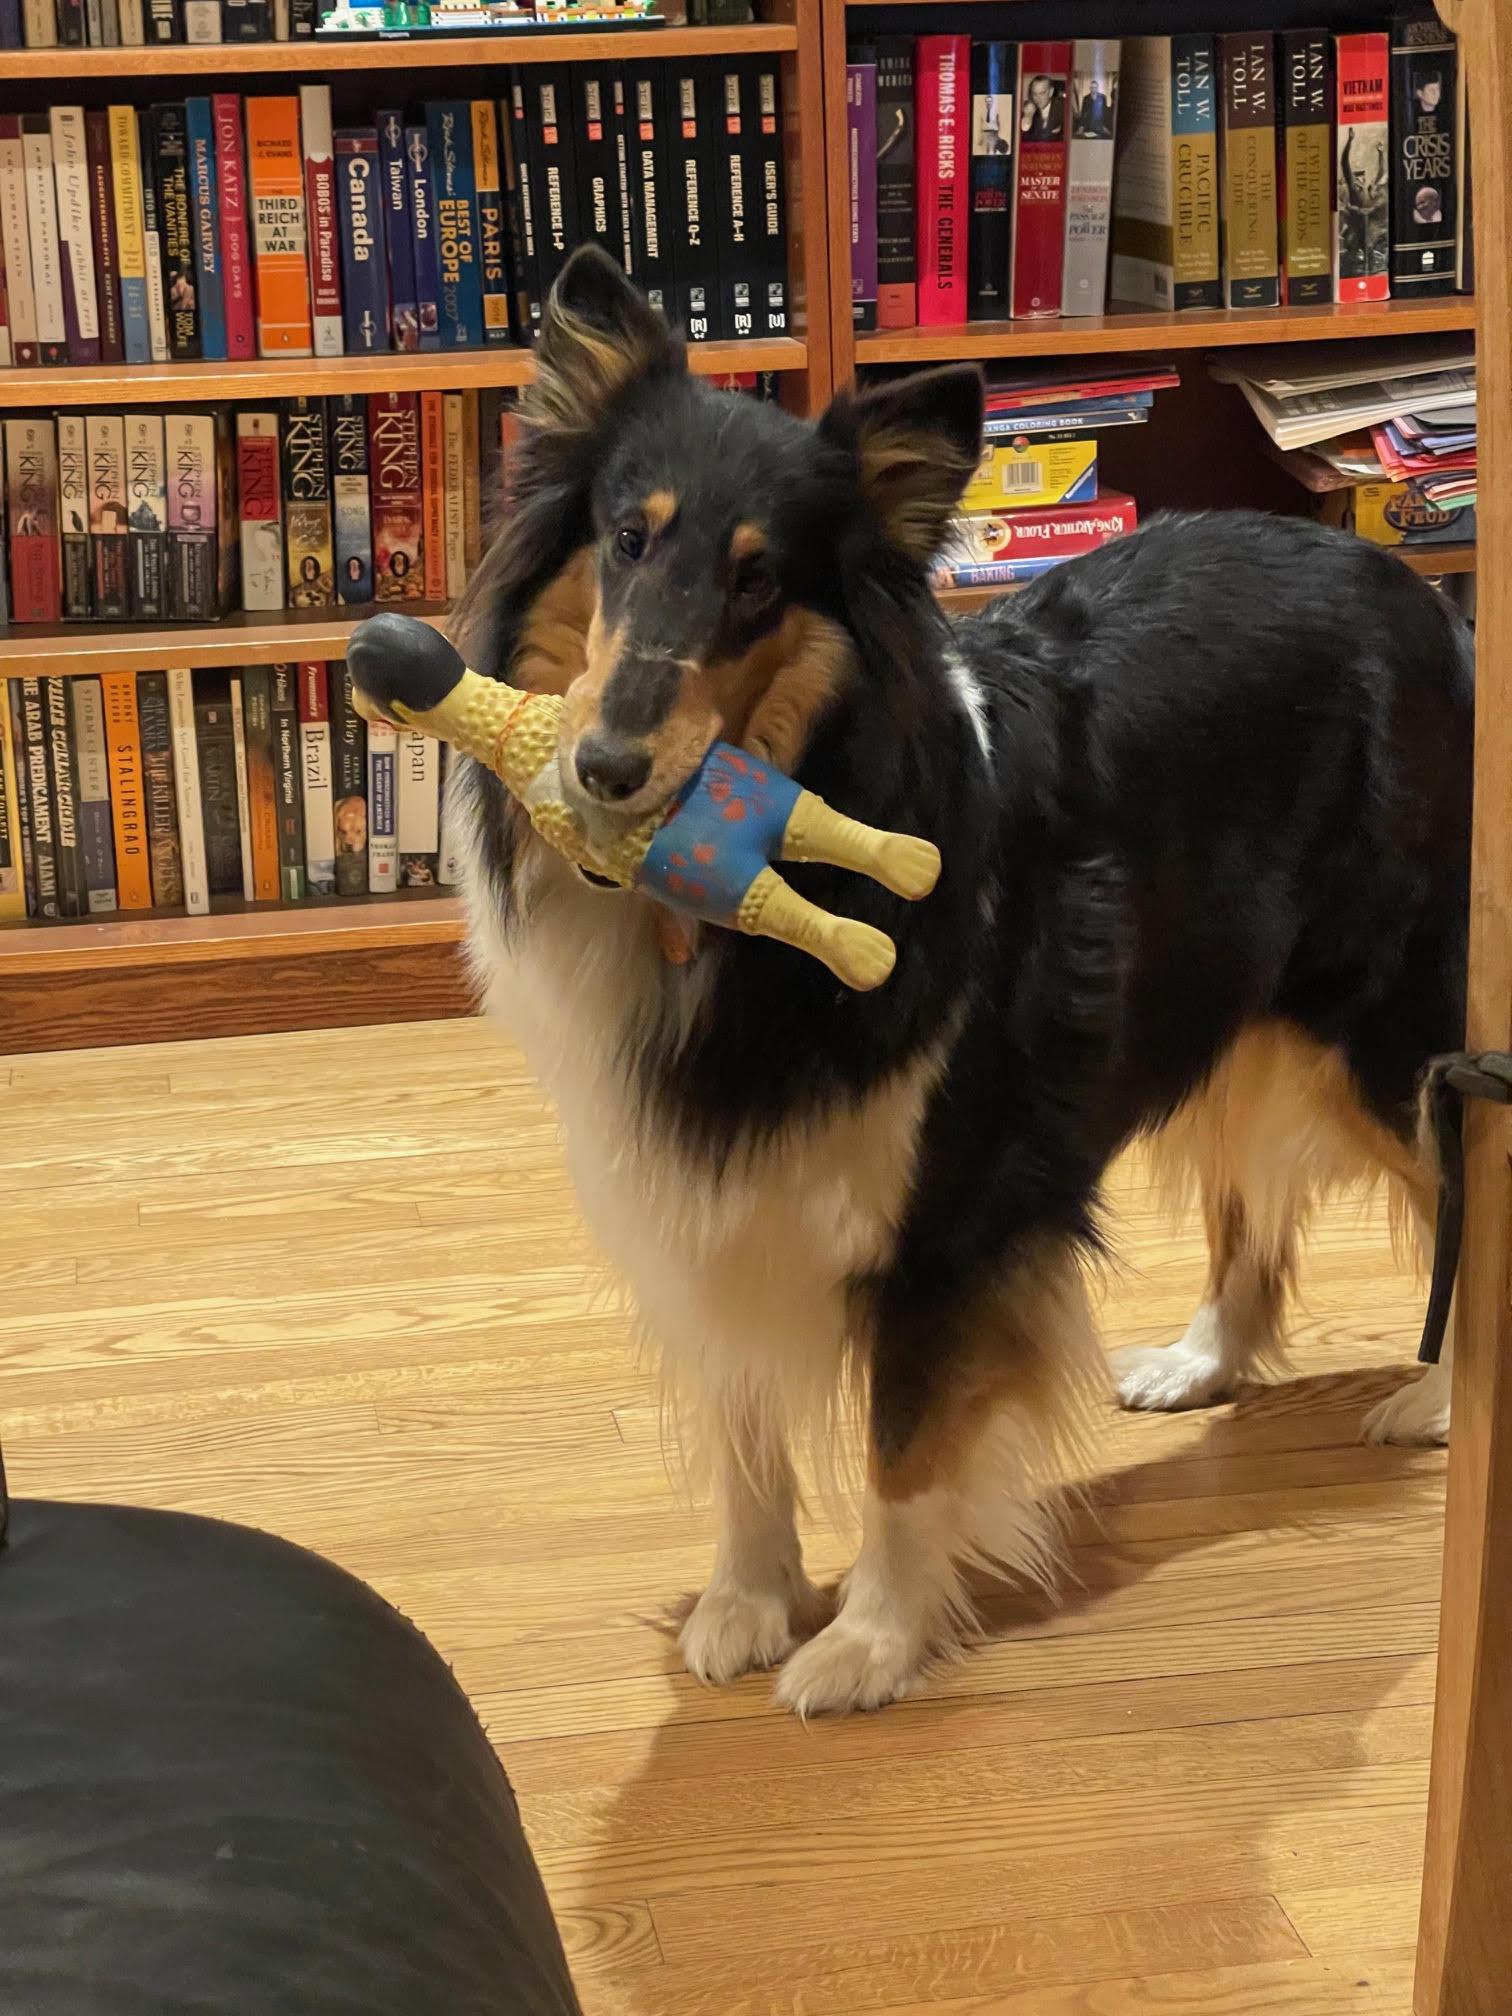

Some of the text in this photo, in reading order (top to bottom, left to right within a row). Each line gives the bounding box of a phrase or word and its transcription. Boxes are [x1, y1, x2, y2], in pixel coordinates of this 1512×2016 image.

[1176, 56, 1191, 114] TOLL
[1194, 50, 1210, 122] IAN W.
[1232, 51, 1247, 109] TOLL
[1251, 45, 1265, 114] IAN W.
[1291, 49, 1306, 107] TOLL
[1309, 43, 1323, 112] IAN W.
[1343, 78, 1383, 95] VIETNAM
[62, 129, 75, 169] John
[117, 115, 129, 159] TOWARD
[1403, 133, 1451, 158] CRISIS
[1417, 116, 1437, 132] THE
[315, 173, 331, 213] BOBOS
[388, 158, 404, 210] Taiwan
[618, 162, 627, 191] STARTED
[685, 159, 697, 222] REFERENCE
[730, 155, 743, 217] REFERENCE
[937, 53, 956, 289] THOMAS E. RICKS THE GENERALS
[1020, 176, 1061, 186] MASTER
[1020, 190, 1060, 200] SENATE
[1178, 143, 1192, 247] CRUCIBLE
[1196, 153, 1212, 232] PACIFIC
[1233, 172, 1244, 207] TIDE
[1246, 136, 1257, 240] CONQUERING
[1260, 170, 1272, 201] THE
[1296, 132, 1309, 241] OF THE GODS
[1309, 144, 1321, 228] TWILIGHT
[1403, 157, 1451, 181] YEARS
[66, 174, 81, 232] Updike
[120, 161, 136, 236] COMMITMENT
[146, 212, 156, 230] THE
[163, 176, 179, 256] THE VANITIES
[174, 166, 191, 265] THE BONFIRE OF
[194, 138, 215, 273] MARCUS GARVEY
[218, 115, 242, 298] JON KATZ DOG DAYS
[258, 198, 298, 211] THIRD
[258, 212, 300, 224] REICH
[319, 215, 331, 228] in
[349, 157, 374, 262] Canada
[414, 178, 429, 239] London
[521, 184, 531, 221] REFERENCE
[547, 166, 562, 230] REFERENCE
[592, 177, 607, 233] GRAPHICS
[620, 191, 628, 208] WITH
[642, 150, 658, 258] DATA MANAGEMENT
[764, 161, 778, 235] USER'S GUIDE
[264, 240, 296, 251] WAR
[271, 227, 287, 237] AT
[318, 230, 333, 282] Paradise
[456, 199, 473, 263] BEST OF
[481, 208, 502, 280] PARIS
[439, 199, 460, 321] EUROPE 2007
[176, 311, 187, 347] WOLFE
[184, 311, 194, 336] TOM
[332, 416, 356, 469] KING
[355, 416, 364, 468] STEPHEN
[373, 410, 405, 488] KING
[403, 410, 418, 489] STEPHEN
[1013, 417, 1084, 431] COLORING BOOK
[19, 455, 37, 502] KING
[62, 452, 77, 499] KING
[94, 452, 111, 500] KING
[132, 451, 149, 497] KING
[177, 451, 194, 499] KING
[285, 414, 313, 498] KING
[310, 414, 325, 497] STEPHEN
[242, 448, 263, 516] KING
[448, 432, 460, 562] The FEDERALIST Papers
[1014, 516, 1123, 539] KING ARTHUR FLOUR
[1399, 510, 1450, 527] FEUD
[970, 567, 1015, 584] BAKING
[110, 683, 121, 724] BEEVOR
[122, 683, 133, 723] ANTONY
[174, 671, 185, 690] Why
[306, 666, 318, 717] Frommer's
[83, 689, 99, 791] STORM CENTER
[141, 696, 156, 751] SHAARA
[155, 698, 167, 749] MICHAEL
[281, 729, 291, 768] Northern
[344, 718, 358, 745] Way
[25, 700, 51, 843] ARAB PREDICAMENT
[181, 746, 190, 769] Good
[183, 771, 192, 783] for
[305, 729, 328, 790] Brazil
[343, 753, 352, 789] MILLAN
[353, 756, 361, 784] CESAR
[51, 728, 76, 848] COLLAR CRIME
[117, 744, 140, 855] STALINGRAD
[282, 770, 293, 804] Virginia
[150, 754, 173, 891] THE KILLER ANGELS
